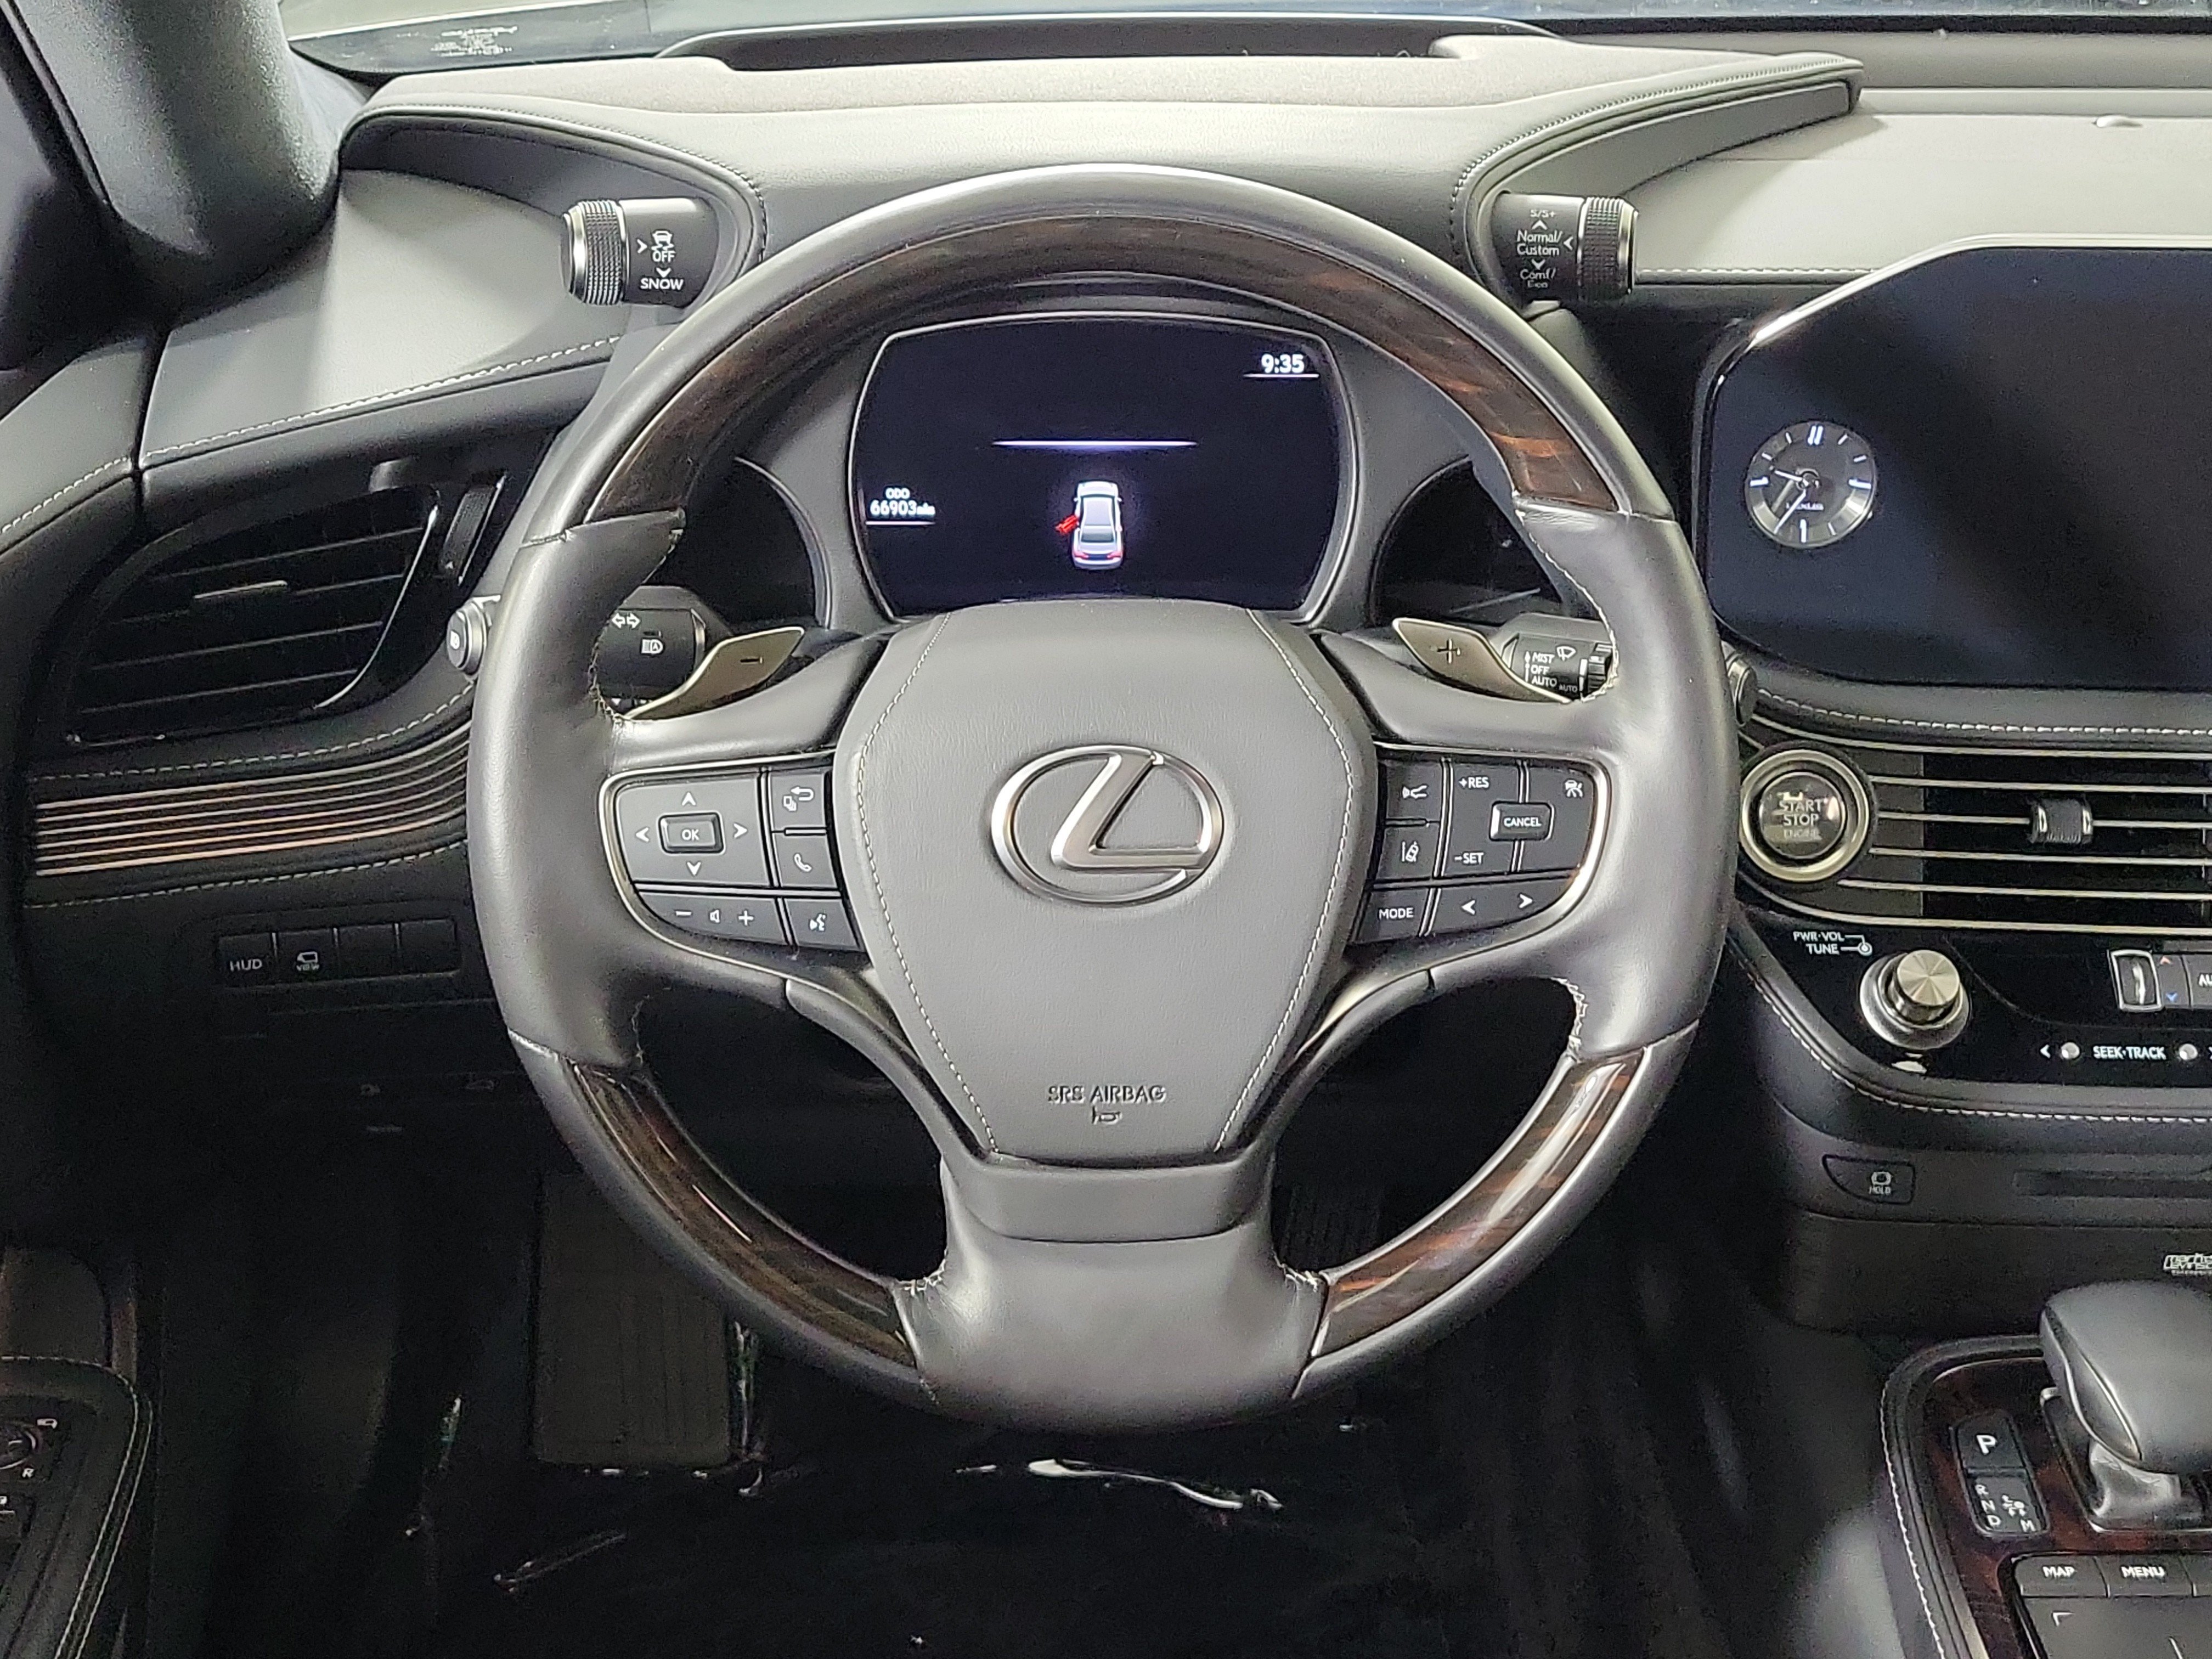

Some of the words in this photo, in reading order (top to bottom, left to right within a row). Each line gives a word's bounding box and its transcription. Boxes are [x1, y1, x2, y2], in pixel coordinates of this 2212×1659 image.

[1517, 243, 1560, 256] Custom
[652, 251, 675, 262] OFF
[640, 278, 684, 290] SNOW
[1527, 280, 1548, 288] Eco
[1261, 353, 1305, 373] 9:35
[885, 488, 910, 499] ODO
[1532, 651, 1555, 663] MIST
[1531, 664, 1550, 675] OFF
[1531, 675, 1558, 687] AUTO
[1559, 684, 1578, 692] AUTO
[1459, 777, 1489, 788] +RES
[1779, 798, 1824, 812] START
[1503, 817, 1542, 827] CANCEL
[1783, 813, 1819, 826] STOP
[681, 828, 699, 840] OK
[1378, 907, 1414, 919] MODE
[1805, 943, 1839, 955] TUNE
[229, 958, 263, 972] HUD
[1048, 1085, 1085, 1104] SRS
[1090, 1085, 1166, 1104] AIRBAG
[1976, 1435, 1997, 1454] P
[22, 1468, 35, 1478] R
[1975, 1484, 1989, 1495] R
[1981, 1500, 1995, 1511] N
[1987, 1515, 2001, 1526] D
[2020, 1519, 2036, 1532] M
[2042, 1566, 2075, 1578] MAP
[2121, 1566, 2165, 1578] MENU
